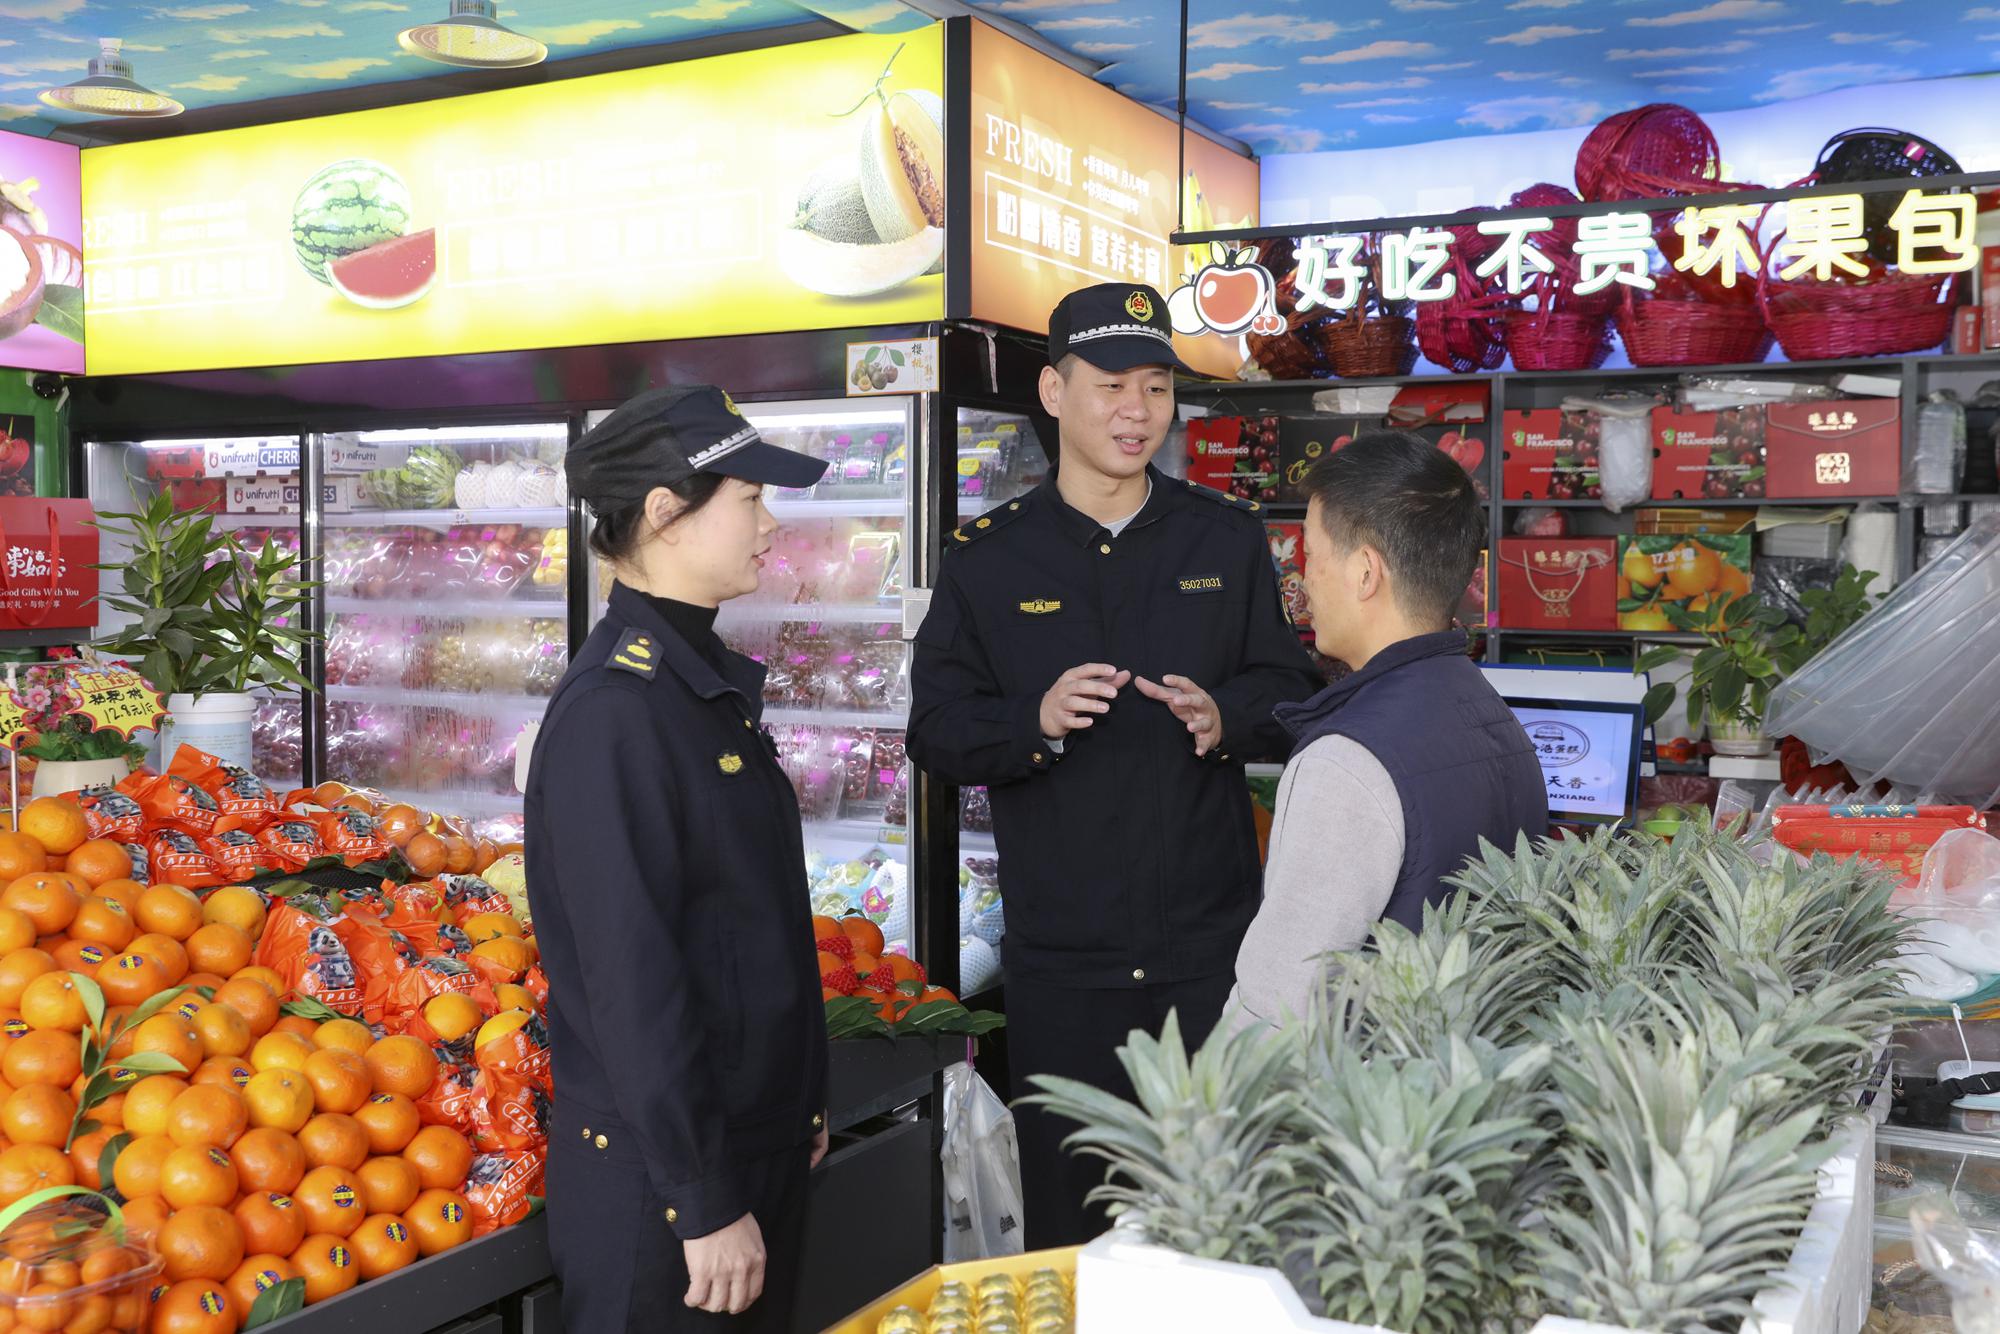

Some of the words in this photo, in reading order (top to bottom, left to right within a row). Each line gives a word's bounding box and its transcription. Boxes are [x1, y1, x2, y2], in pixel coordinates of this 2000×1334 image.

[985, 112, 1073, 187] FRESH
[1291, 189, 1980, 310] 好吃不贵坏果包
[221, 450, 258, 463] unifrutti
[260, 448, 300, 465] CHERR
[1208, 447, 1249, 455] FRANCISCO
[245, 488, 280, 501] unifrutti
[1179, 577, 1222, 590] 35027031
[22, 588, 41, 596] Gifts
[44, 588, 63, 596] Wth
[65, 588, 80, 596] You
[1548, 793, 1596, 802] NXIANG
